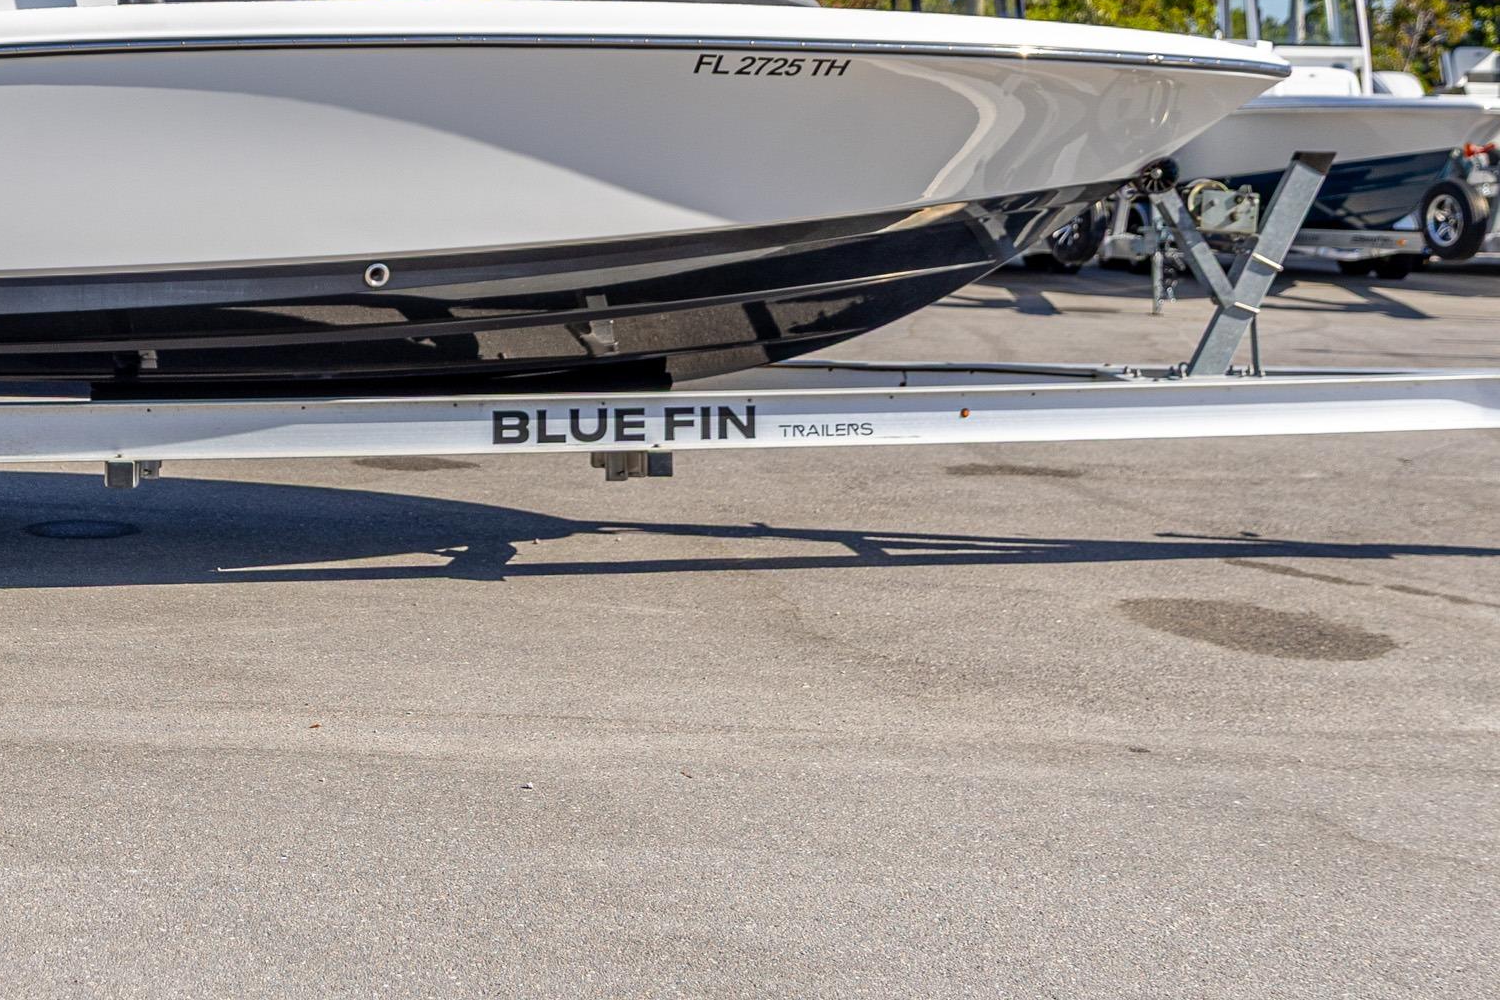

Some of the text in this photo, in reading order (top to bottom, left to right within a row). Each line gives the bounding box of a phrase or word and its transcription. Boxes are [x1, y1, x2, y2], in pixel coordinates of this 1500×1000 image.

[693, 53, 852, 77] FL 2725 TH
[491, 404, 874, 445] BLUE FIN TRAILERS
